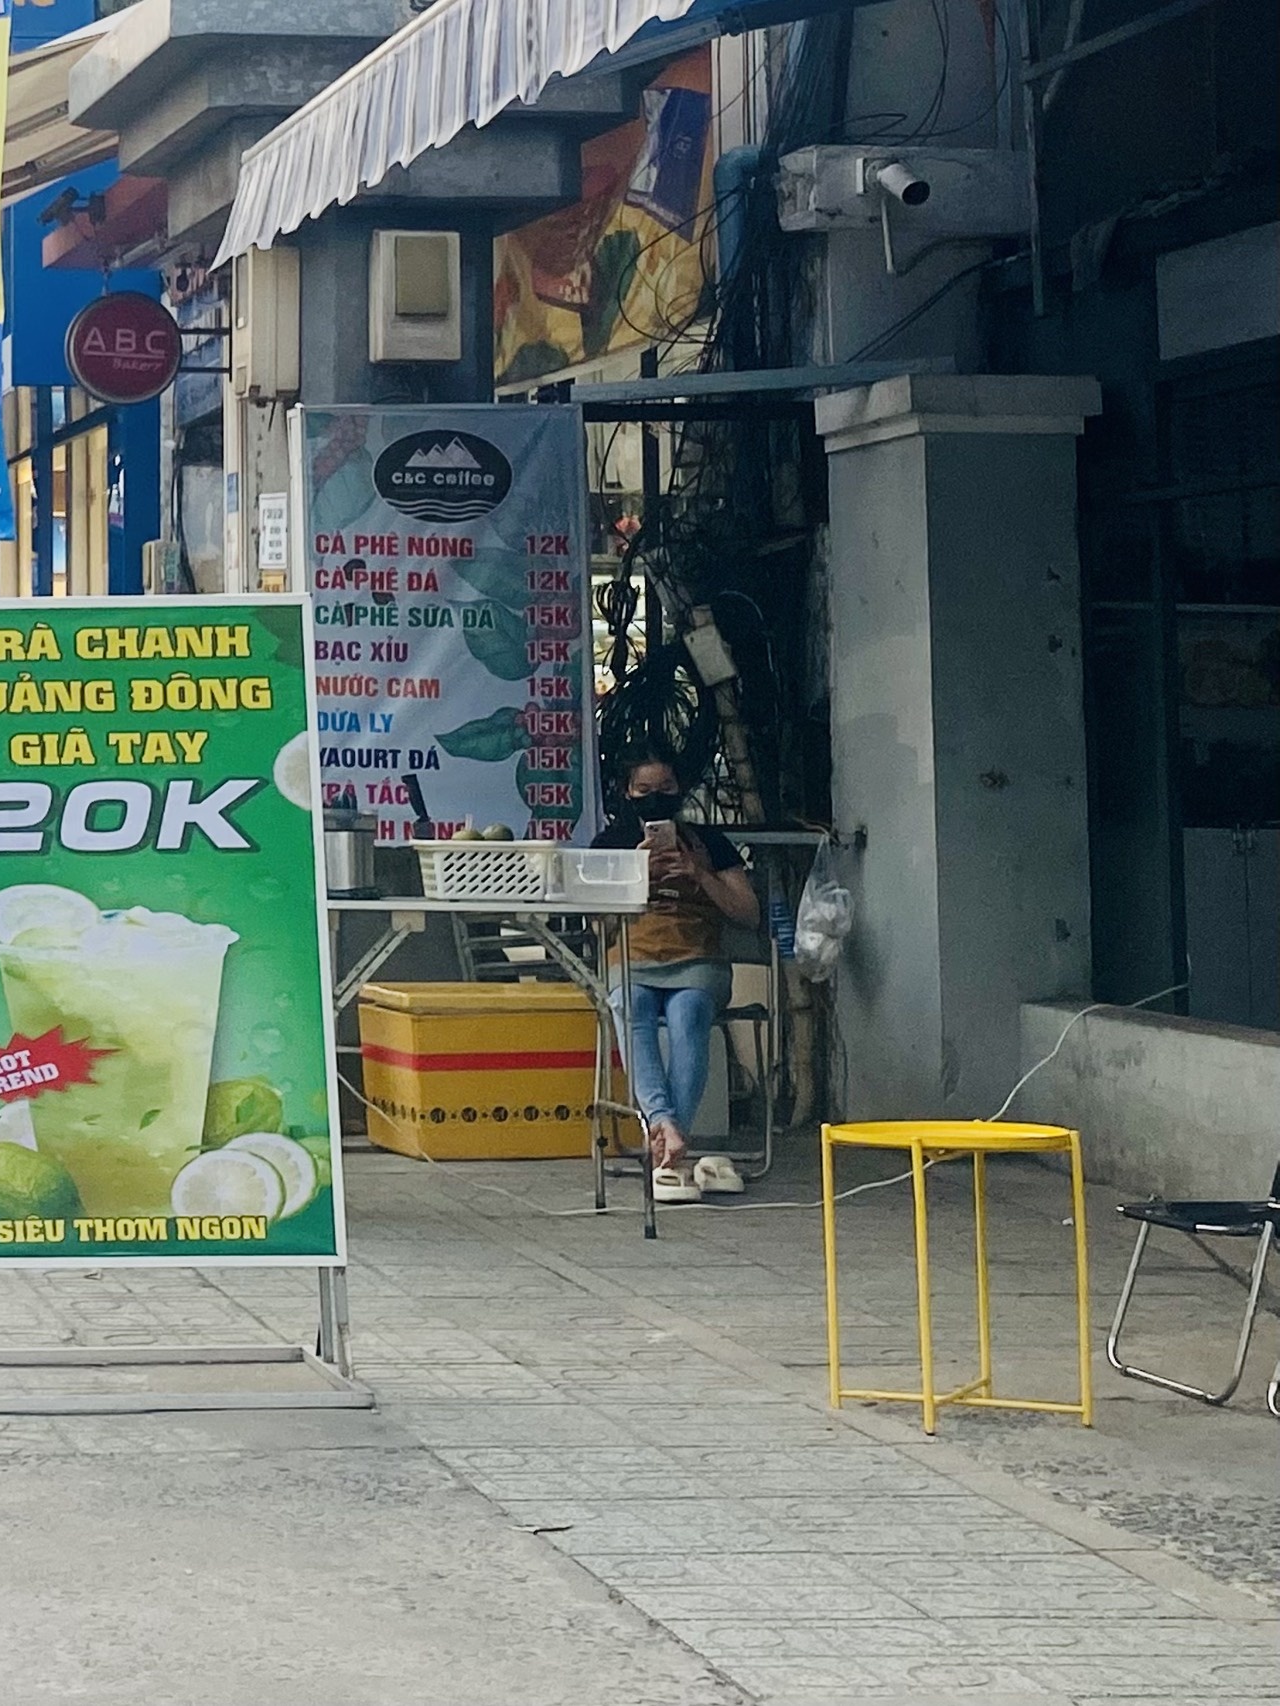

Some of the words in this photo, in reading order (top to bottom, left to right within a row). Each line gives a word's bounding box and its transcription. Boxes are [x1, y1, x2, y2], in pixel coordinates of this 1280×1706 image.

[83, 327, 167, 355] ABC
[392, 472, 426, 485] C&C
[315, 530, 346, 555] CÀ
[354, 532, 399, 556] PHÊ
[408, 532, 473, 557] NÓNG
[526, 534, 570, 556] 12K
[315, 566, 346, 590] CÀ
[354, 567, 399, 591] PHÊ
[526, 570, 570, 591] 12K
[315, 601, 346, 625] CÀ
[354, 602, 399, 627] PHÊ
[408, 602, 454, 628] SỮA
[463, 604, 494, 629] ĐÁ
[526, 606, 571, 627] 15K
[75, 625, 251, 661] CHANH
[315, 639, 362, 666] BẠC
[371, 635, 409, 663] XỈU
[526, 642, 571, 662] 15K
[130, 671, 273, 713] ĐÔNG
[316, 673, 379, 697] NƯỚC
[387, 677, 441, 698] CAM
[526, 679, 571, 698] 15K
[369, 712, 394, 733] LY
[526, 711, 571, 734] 15K
[10, 727, 97, 766] GIÃ
[108, 730, 209, 765] TAY
[408, 745, 440, 770] ĐÁ
[526, 748, 571, 770] 15K
[526, 784, 571, 805] 15K
[527, 820, 571, 840] 15K
[73, 1217, 168, 1242] THƠM
[176, 1216, 267, 1241] NGON
